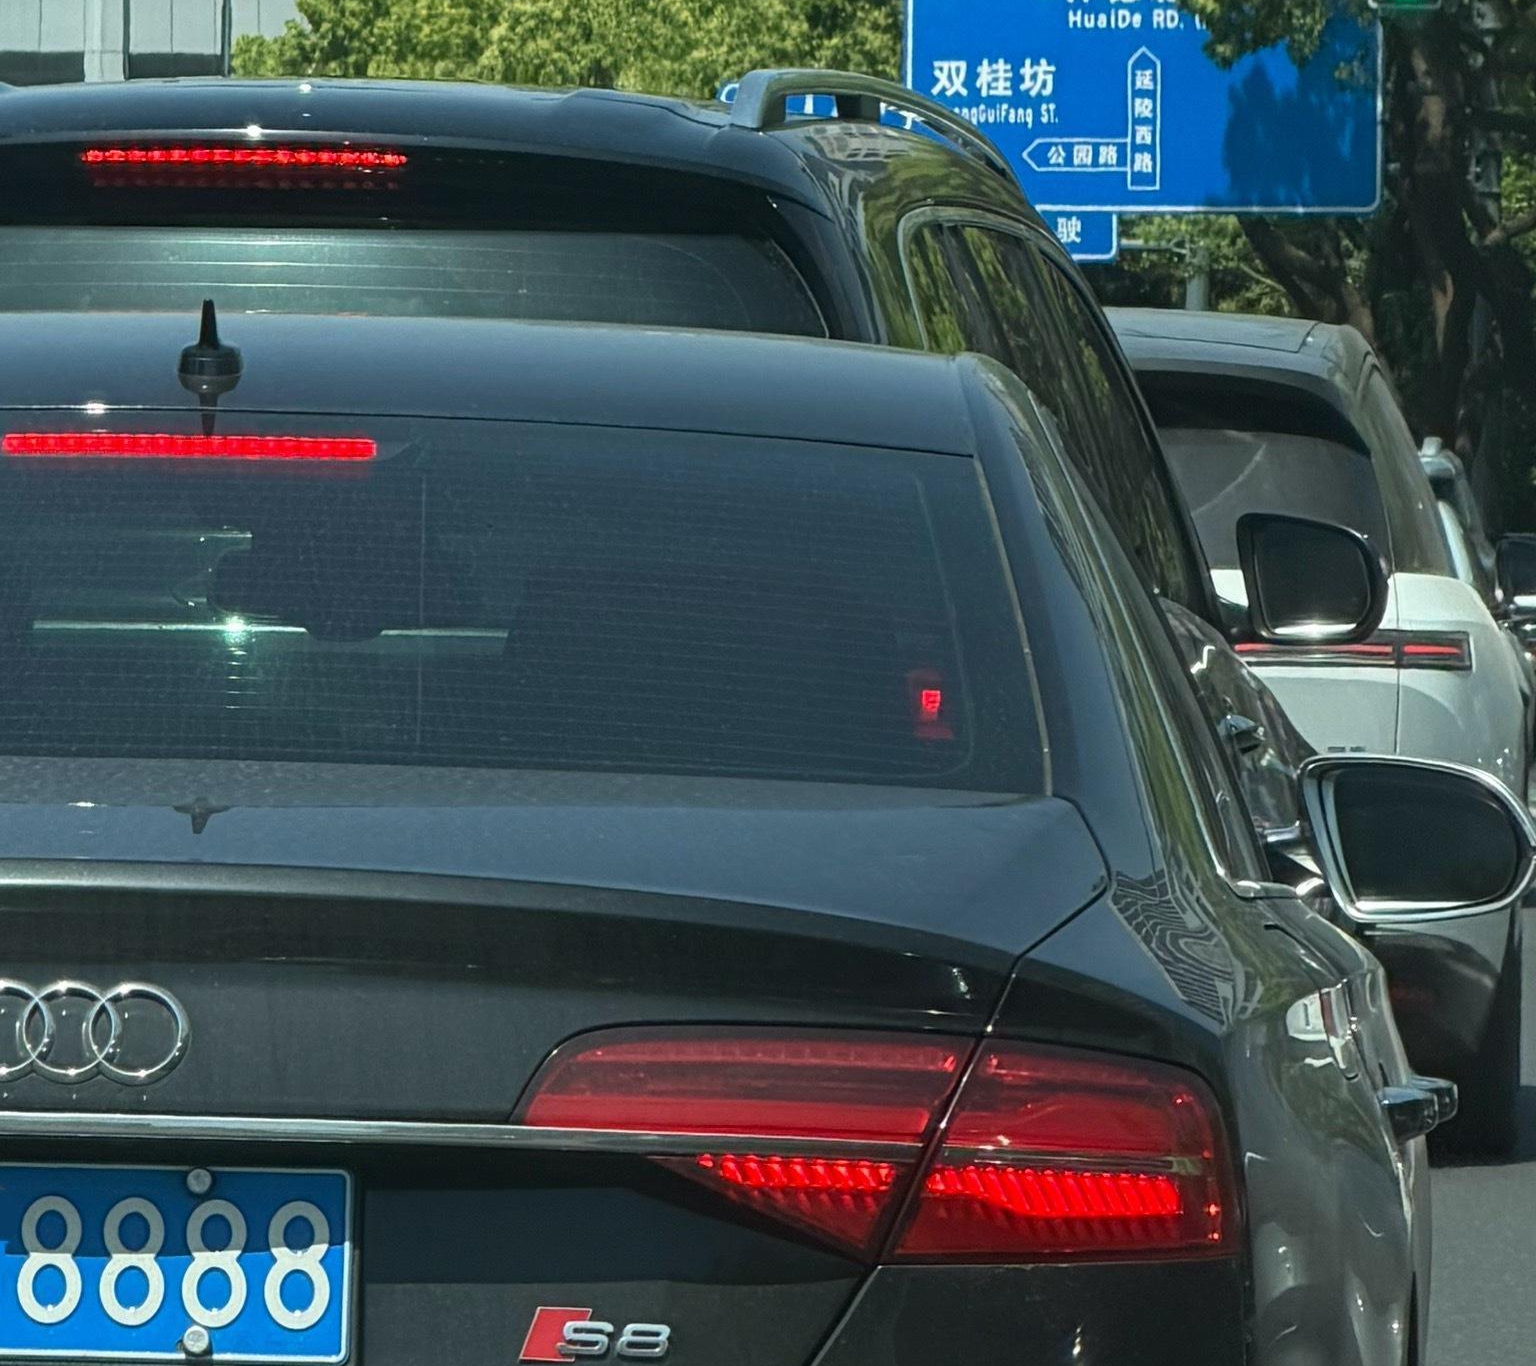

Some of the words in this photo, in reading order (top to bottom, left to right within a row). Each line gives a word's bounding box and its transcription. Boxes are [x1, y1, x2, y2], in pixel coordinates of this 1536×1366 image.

[1152, 8, 1184, 30] RD.
[931, 58, 1056, 97] 双桂坊
[1040, 103, 1059, 124] ST.
[1047, 145, 1118, 167] 公园路
[556, 1321, 671, 1357] S8
